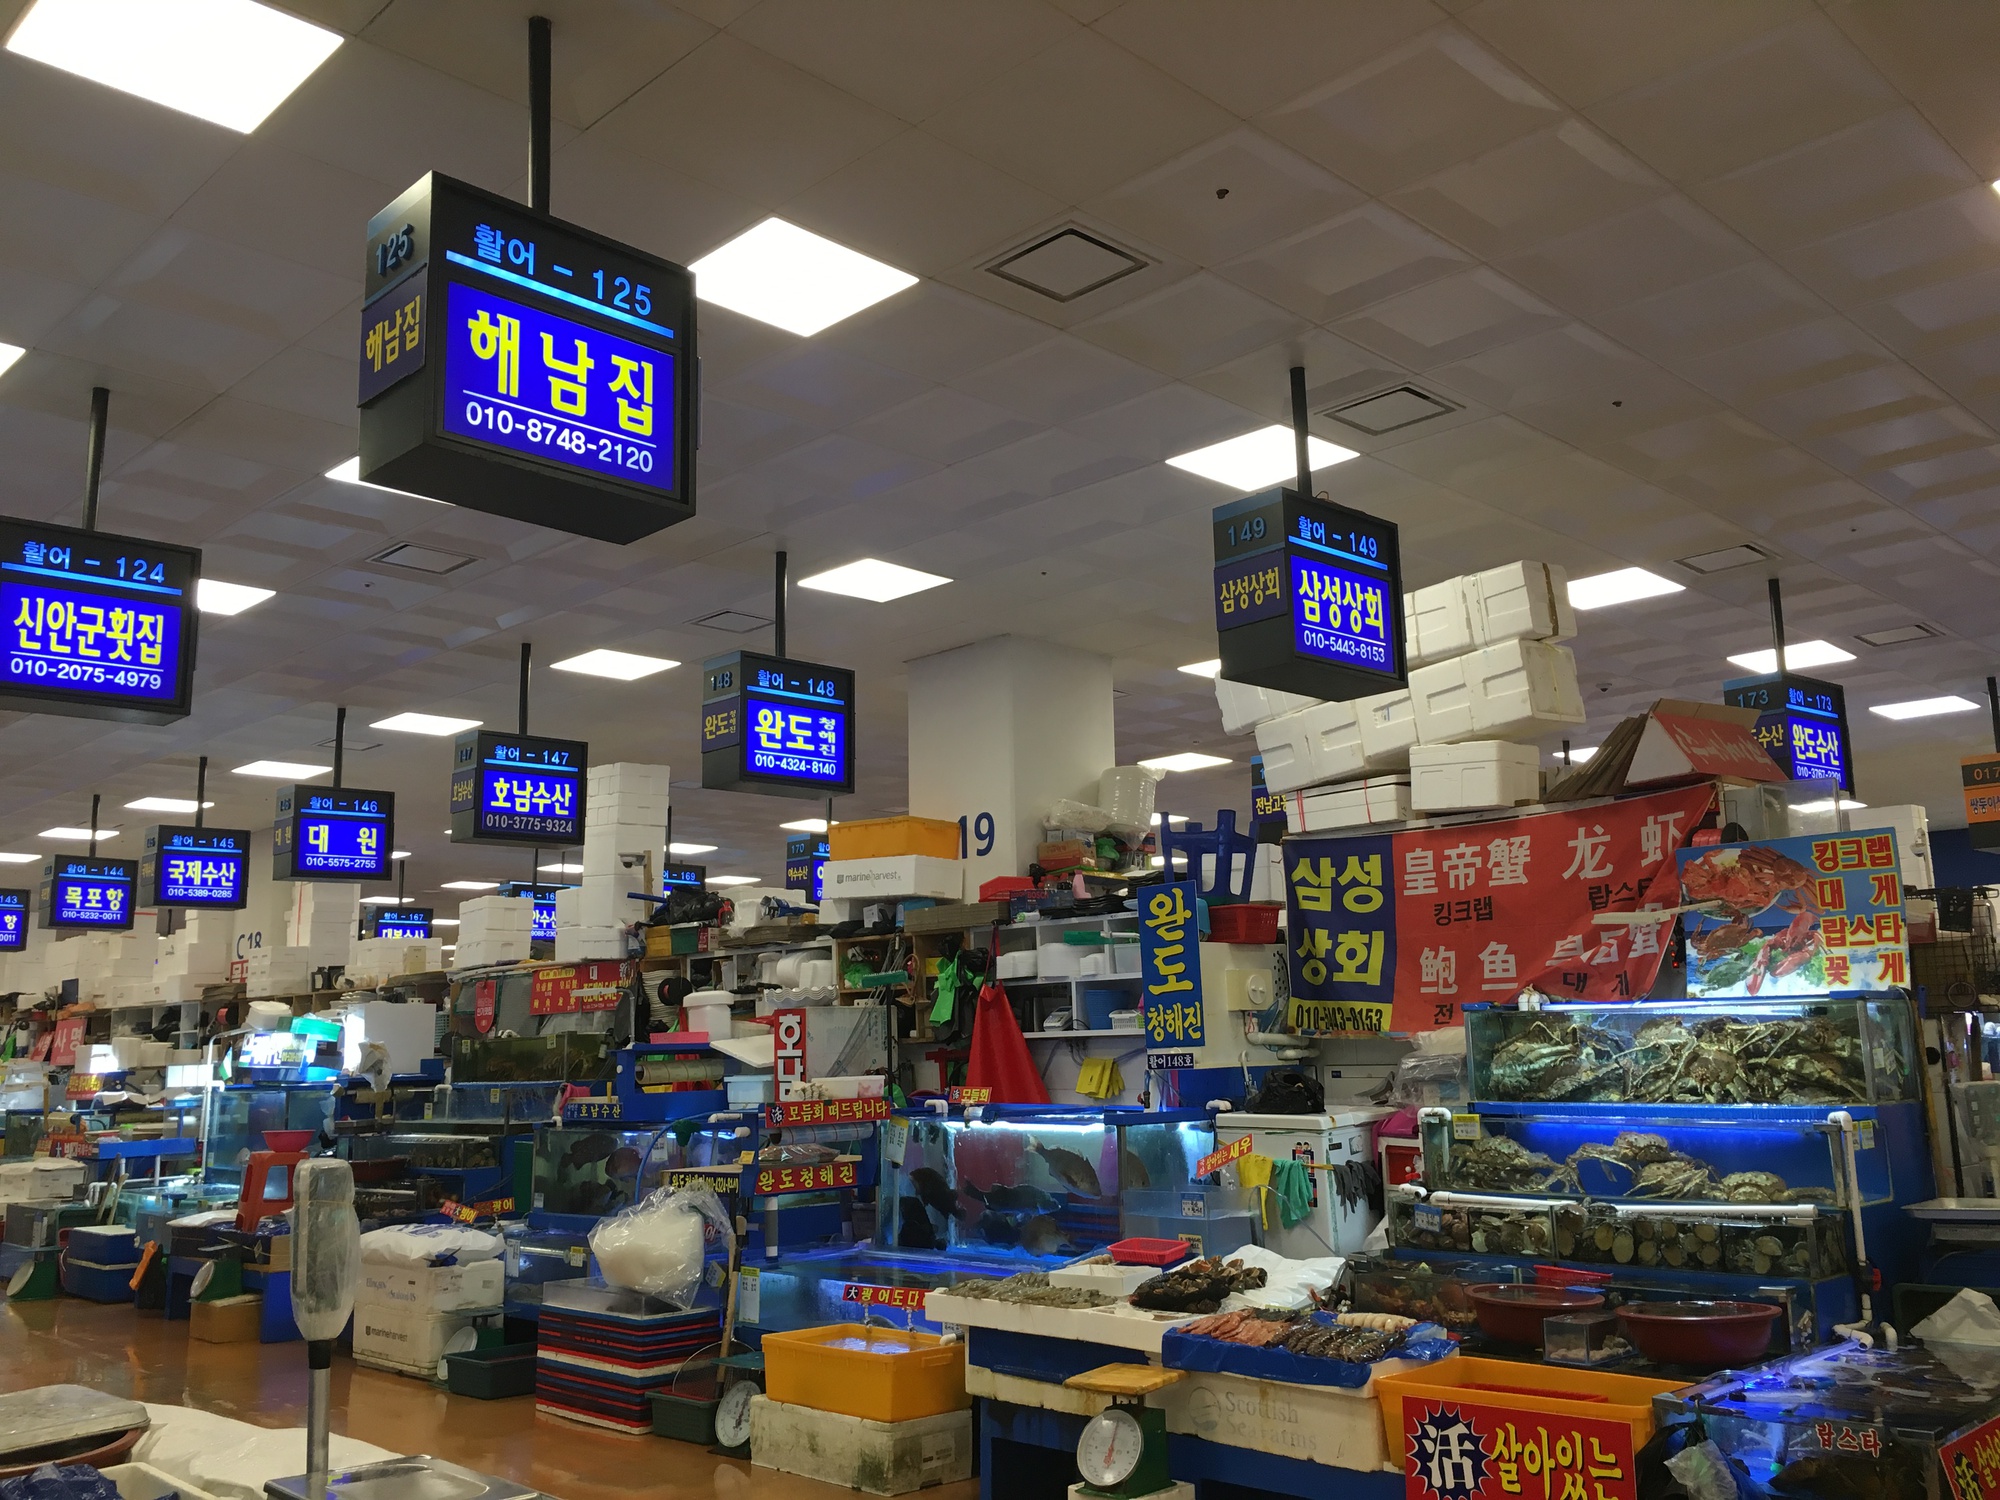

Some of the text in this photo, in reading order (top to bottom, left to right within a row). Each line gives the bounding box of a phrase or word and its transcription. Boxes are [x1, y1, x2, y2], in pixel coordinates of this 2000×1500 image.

[376, 223, 414, 275] 125
[474, 223, 535, 276] 활어
[592, 269, 653, 316] 125
[366, 295, 421, 372] 해남집
[467, 309, 653, 437] 해남집
[466, 401, 653, 473] 010-8748-2120
[1228, 517, 1266, 546] 149
[1299, 515, 1326, 545] 활어
[1350, 532, 1378, 558] 149
[23, 541, 71, 570] 활어
[117, 557, 165, 584] 124
[1220, 566, 1281, 614] 삼성상회
[1299, 570, 1385, 639] 삼성상회
[13, 597, 165, 665] 신안군횟집
[1304, 630, 1386, 663] 010-5443-8153
[10, 657, 162, 689] 010-2075-4979
[711, 671, 733, 690] 148
[758, 669, 784, 690] 활어
[807, 678, 835, 697] 148
[1738, 689, 1769, 708] 173
[1816, 694, 1832, 711] 173
[704, 712, 729, 740] 완도
[755, 708, 815, 751] 완도
[818, 717, 836, 757] 청해진
[495, 744, 520, 761] 활어
[543, 750, 569, 765] 147
[1792, 724, 1840, 766] 완도수산
[755, 754, 836, 775] 010-4324-8140
[310, 796, 333, 810] 활어
[354, 800, 378, 812] 146
[491, 778, 572, 815] 호남수산
[486, 814, 573, 833] 010-3775-9324
[957, 811, 995, 859] 19
[212, 837, 235, 848] 145
[791, 843, 805, 854] 170
[1812, 833, 1895, 873] 킹크랩
[103, 866, 124, 876] 144
[168, 860, 236, 887] 국제수산
[306, 857, 376, 869] 010-5575-2755
[681, 871, 696, 880] 169
[1403, 834, 1531, 896] 皇帝蟹
[65, 886, 124, 911] 목포항
[168, 887, 233, 898] 010-5389-0285
[545, 892, 556, 900] 16
[1291, 854, 1384, 914] 삼성
[62, 911, 121, 921] 010-5232-0011
[1434, 895, 1494, 927] 킹크랩
[1821, 912, 1904, 948] 랍스타
[1296, 928, 1385, 986] 상회
[1147, 1001, 1203, 1042] 청해진
[1434, 1004, 1453, 1025] 전
[777, 1014, 804, 1102] 호남
[1149, 1054, 1194, 1069] 활어148호
[961, 1088, 990, 1102] 모듬회
[580, 1104, 621, 1118] 호남수산
[788, 1102, 824, 1122] 모듬회
[828, 1099, 888, 1121] 떠드립니다
[1229, 1136, 1251, 1159] 새우
[460, 1207, 477, 1223] 방어
[492, 1198, 513, 1212] 광어
[892, 1290, 926, 1307] 도다
[1225, 1391, 1300, 1424] Scottish
[1815, 1422, 1883, 1458] 랍스타
[1421, 1422, 1475, 1490] 活
